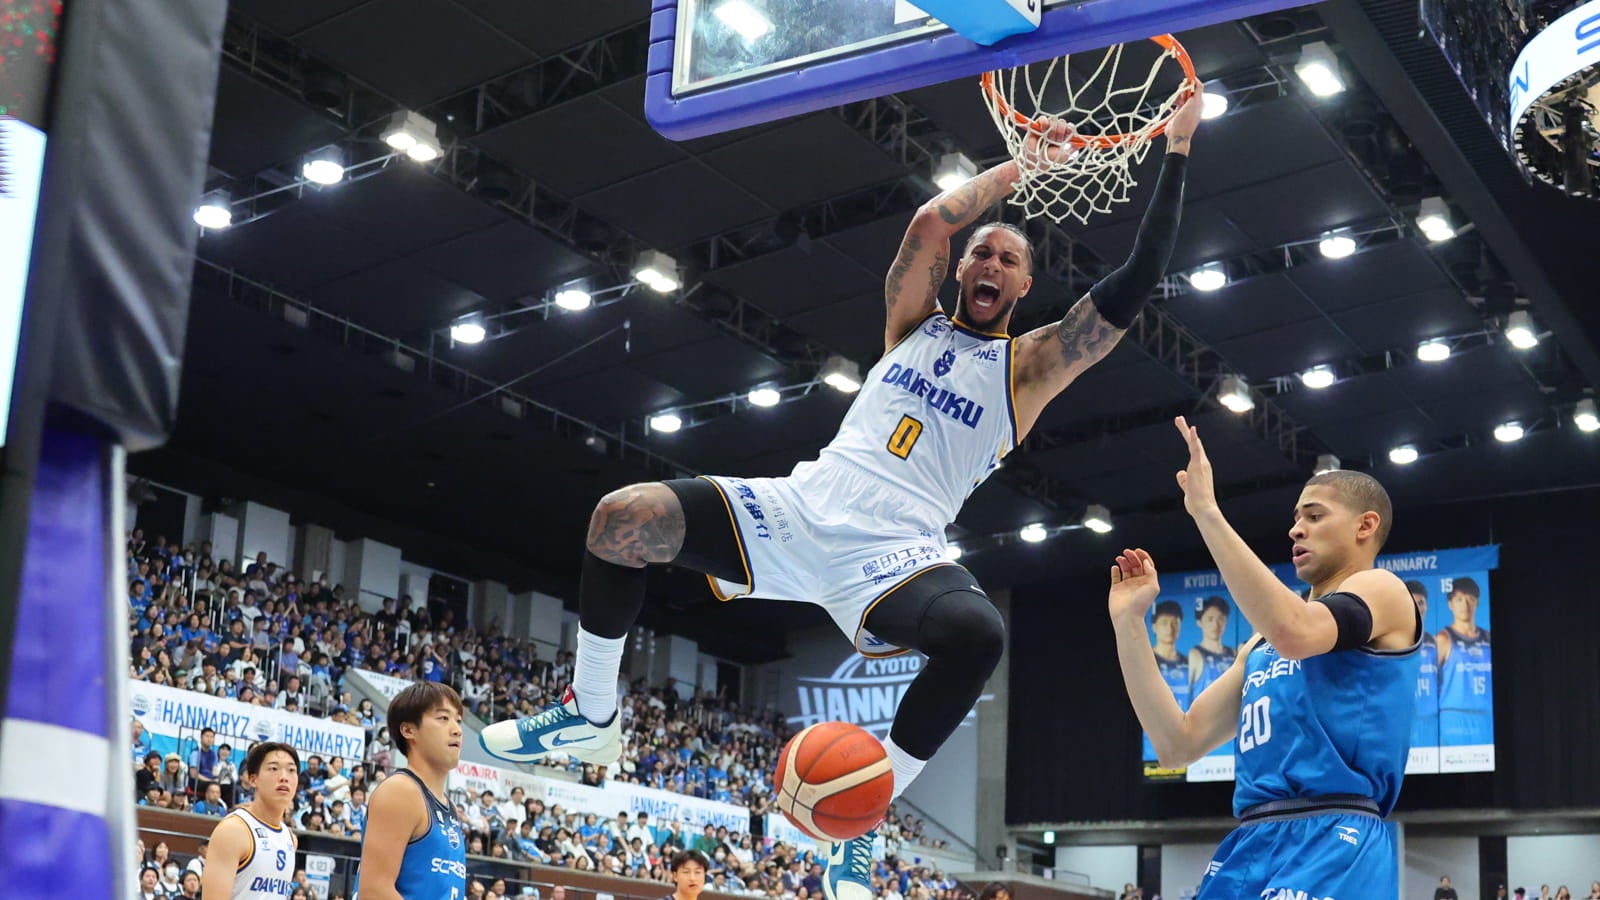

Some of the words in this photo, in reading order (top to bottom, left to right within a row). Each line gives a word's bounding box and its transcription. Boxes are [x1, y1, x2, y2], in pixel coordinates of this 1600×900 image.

[887, 414, 924, 461] 0
[1184, 573, 1218, 589] KYOTO
[1195, 598, 1204, 611] 3
[865, 656, 921, 676] KYOTO
[162, 700, 250, 739] HANNARYZ
[1239, 695, 1271, 754] 20
[284, 724, 362, 758] HANNARYZ
